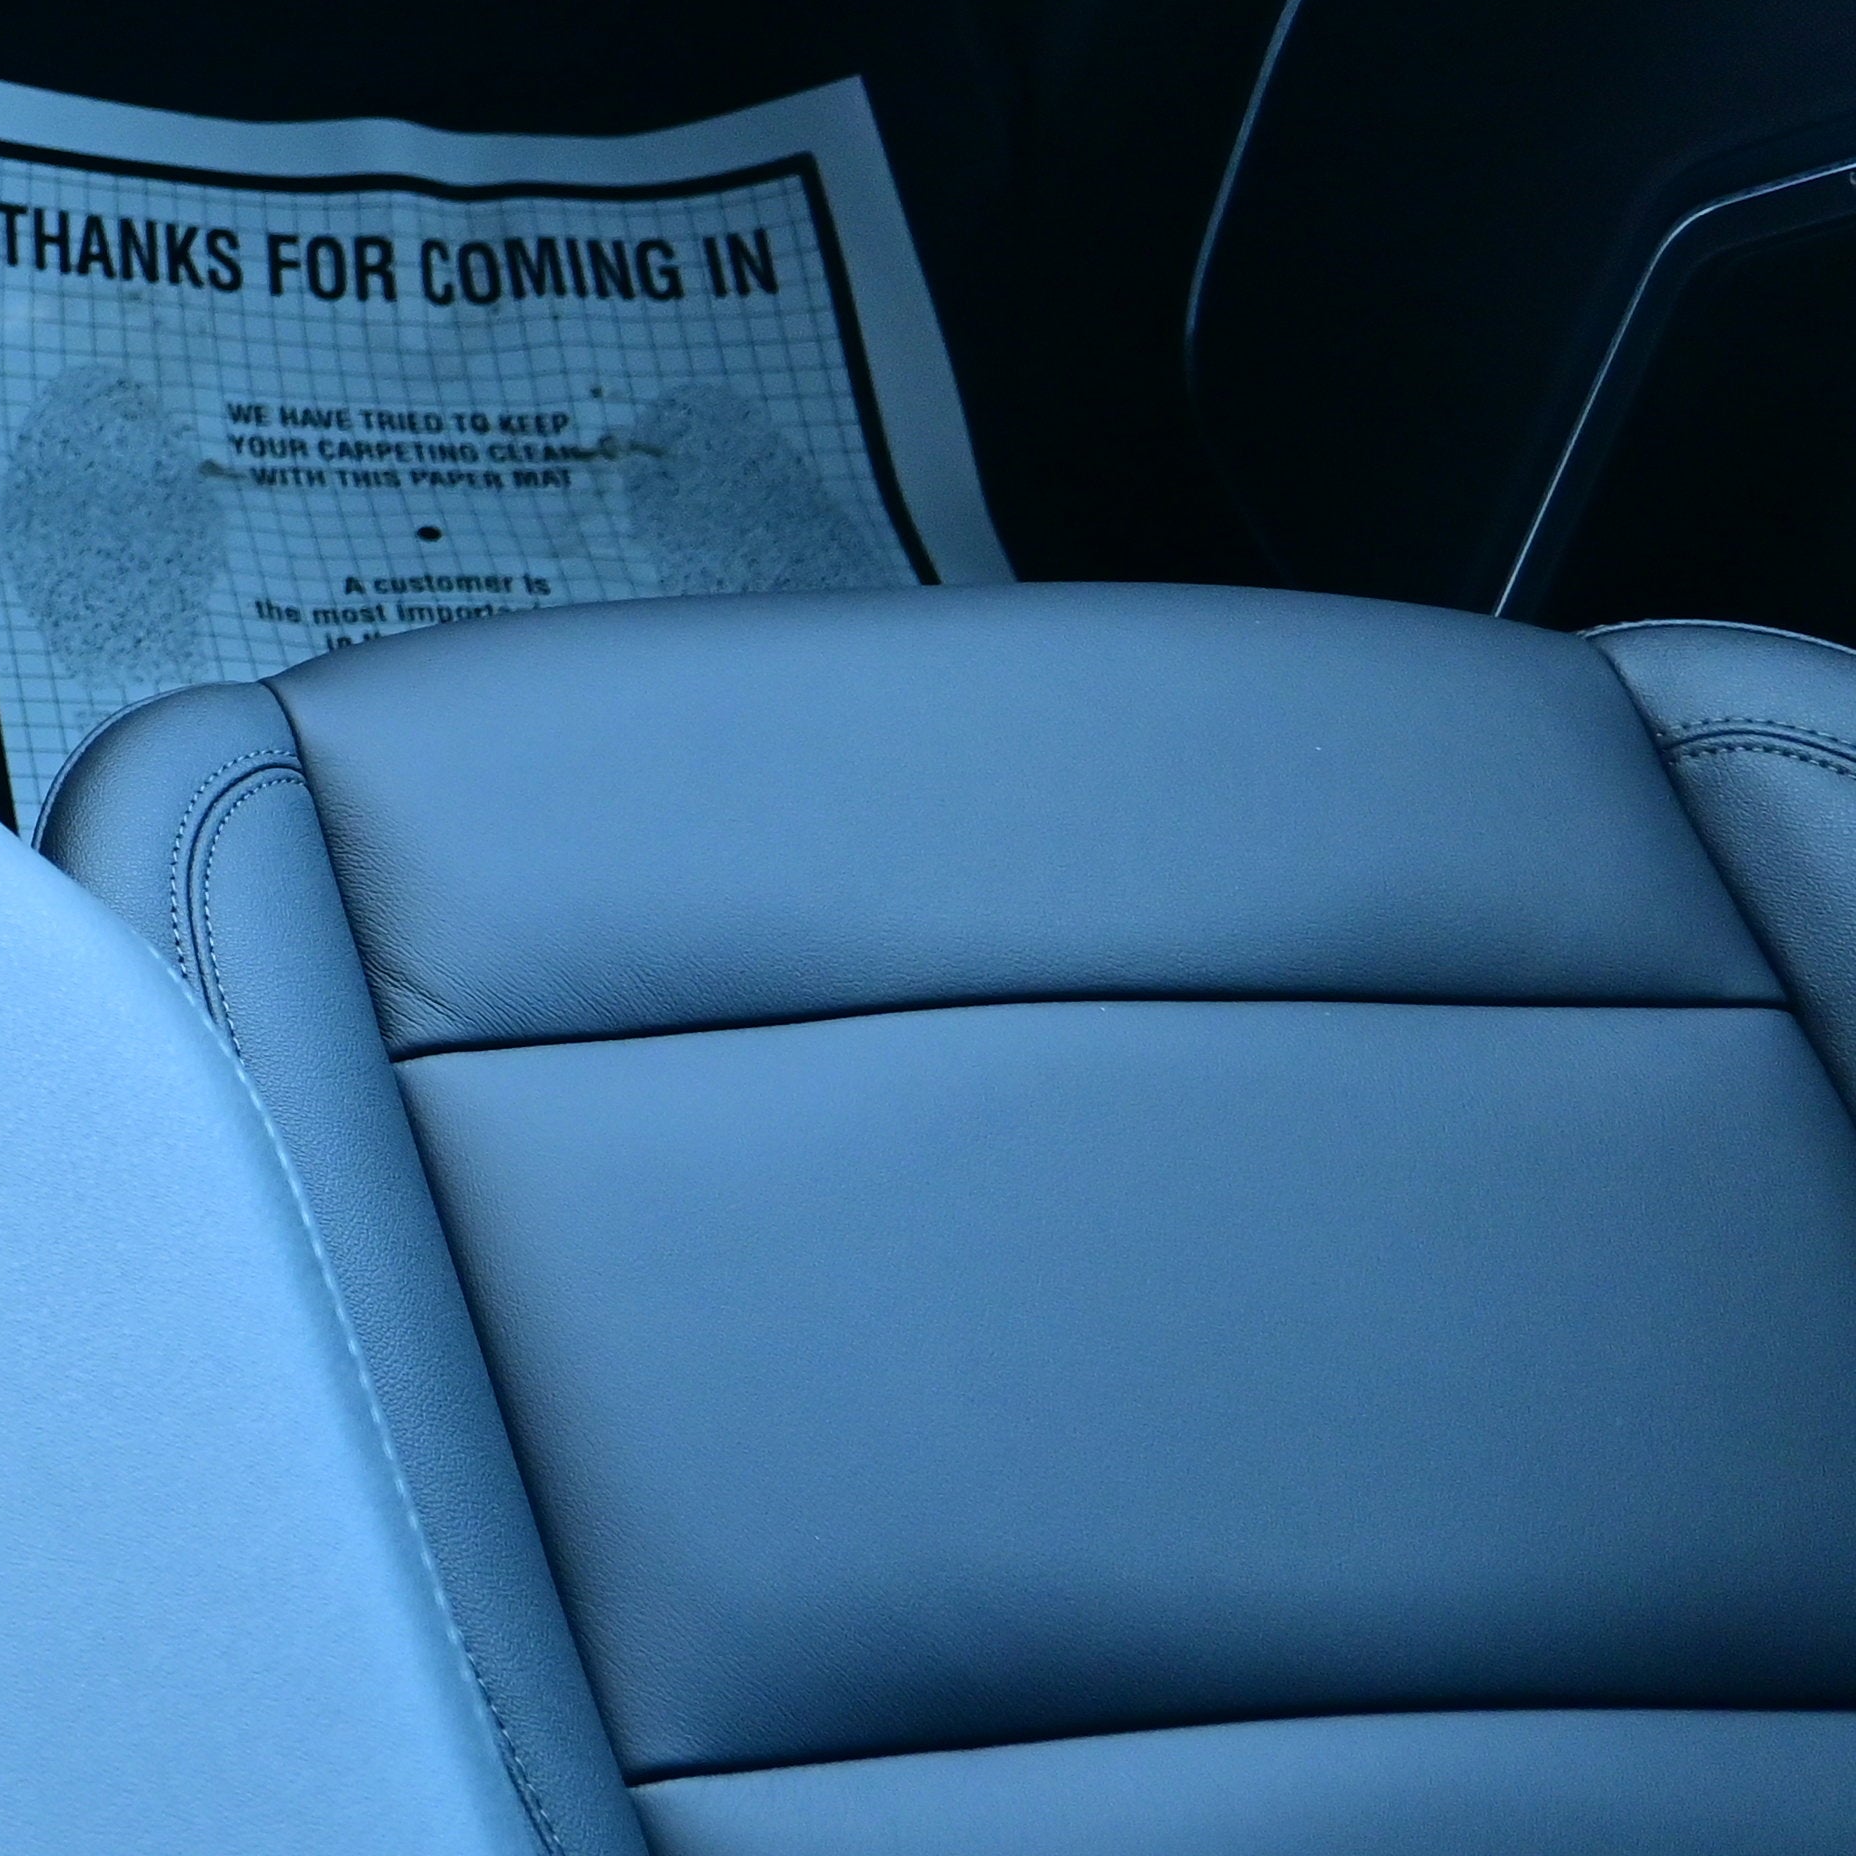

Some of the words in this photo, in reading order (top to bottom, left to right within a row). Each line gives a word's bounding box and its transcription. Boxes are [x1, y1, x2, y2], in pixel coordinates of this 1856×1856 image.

[266, 233, 398, 303] FOR
[420, 235, 684, 307] COMING
[702, 227, 780, 300] IN
[227, 403, 271, 427] WE
[278, 406, 352, 431] HAVE
[359, 409, 444, 434] TRIED
[452, 411, 489, 435] TO
[498, 411, 569, 436] KEEP
[227, 434, 309, 460] YOUR
[317, 440, 479, 464] CARPETING
[488, 442, 580, 464] CLEAN
[249, 467, 327, 488] WITH
[337, 468, 401, 490] THIS
[411, 469, 504, 491] PAPER
[513, 469, 572, 489] MAT
[344, 576, 367, 595] A
[374, 574, 514, 595] customer
[255, 599, 302, 625] the
[313, 603, 386, 626] most
